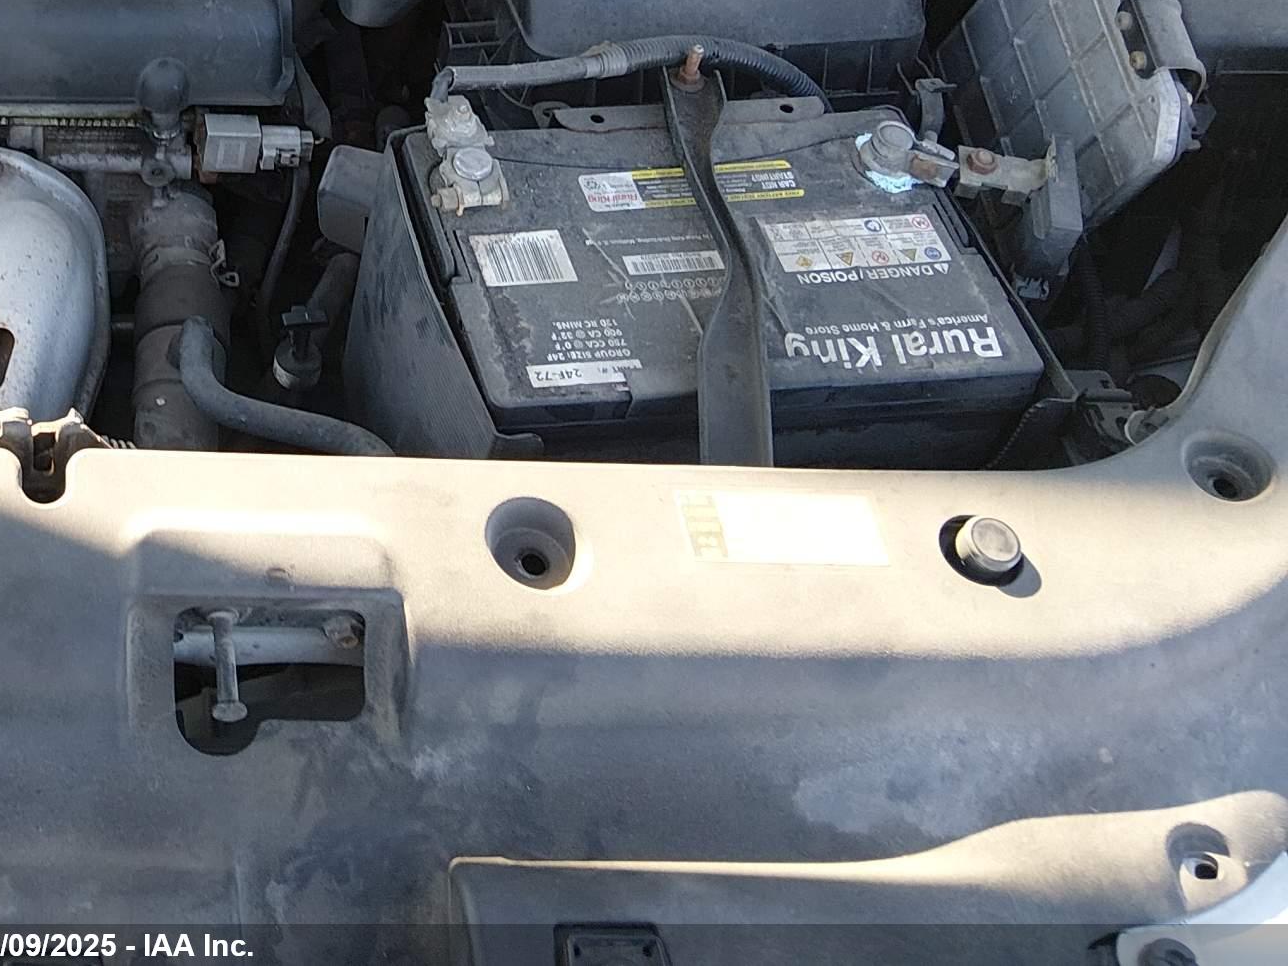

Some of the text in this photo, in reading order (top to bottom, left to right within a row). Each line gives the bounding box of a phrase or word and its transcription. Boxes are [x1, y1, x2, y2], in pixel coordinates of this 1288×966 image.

[805, 314, 988, 336] America's Farm & Home Store
[587, 330, 601, 338] CA
[604, 328, 623, 336] 900
[891, 326, 1002, 364] Rural
[534, 368, 582, 381] 24F-72
